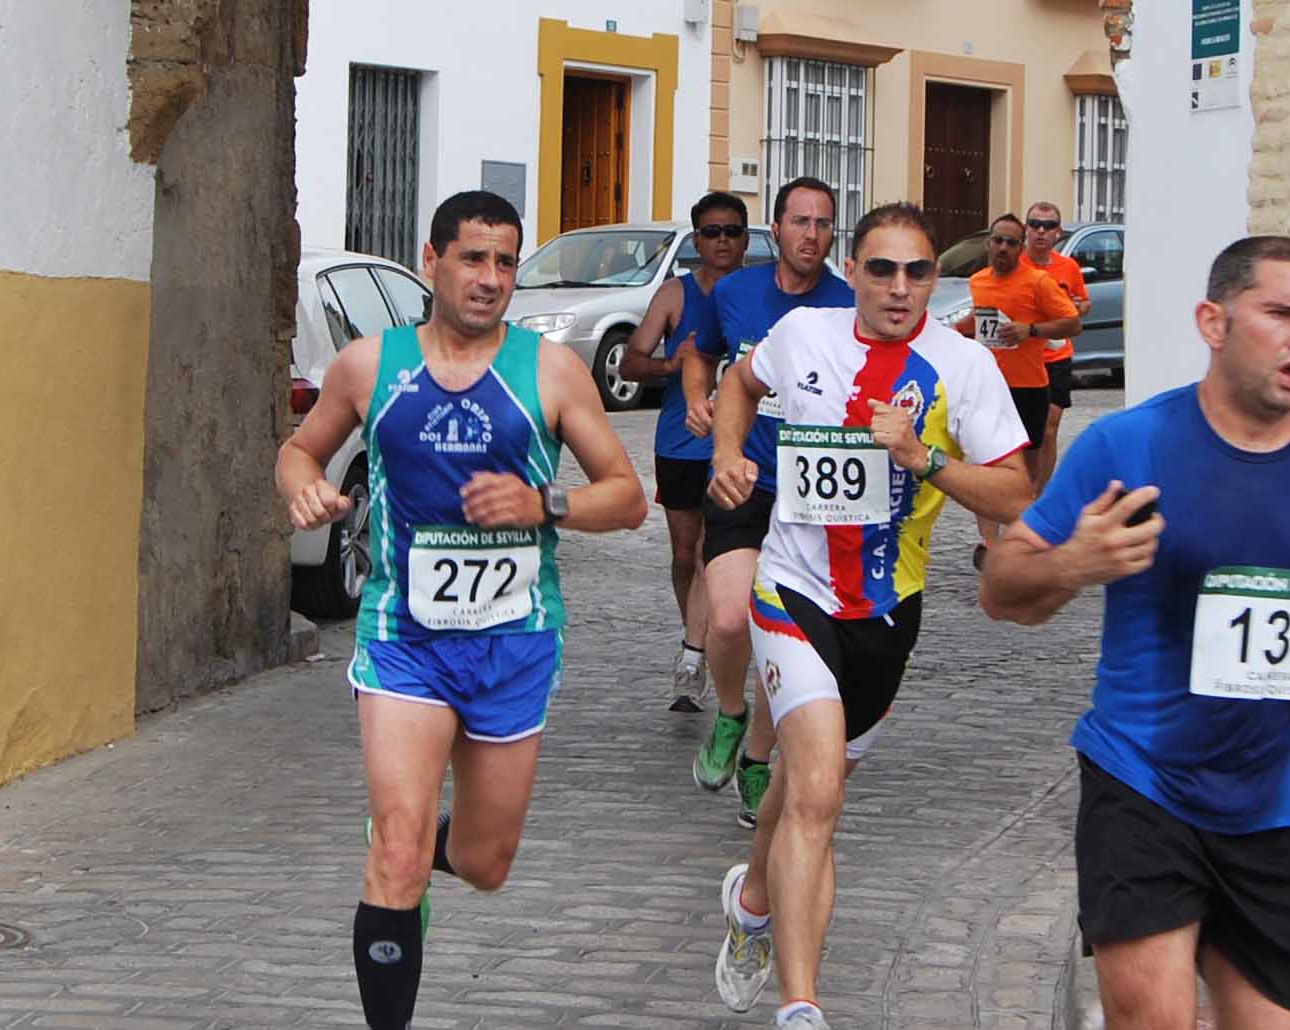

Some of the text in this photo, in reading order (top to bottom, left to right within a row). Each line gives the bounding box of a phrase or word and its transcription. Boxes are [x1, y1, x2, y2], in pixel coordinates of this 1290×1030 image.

[830, 432, 843, 443] DE
[844, 432, 874, 444] SEVIL
[795, 455, 867, 501] 389
[415, 530, 532, 545] DIPUTACIÓN DE SEVILLA
[432, 557, 518, 603] 272
